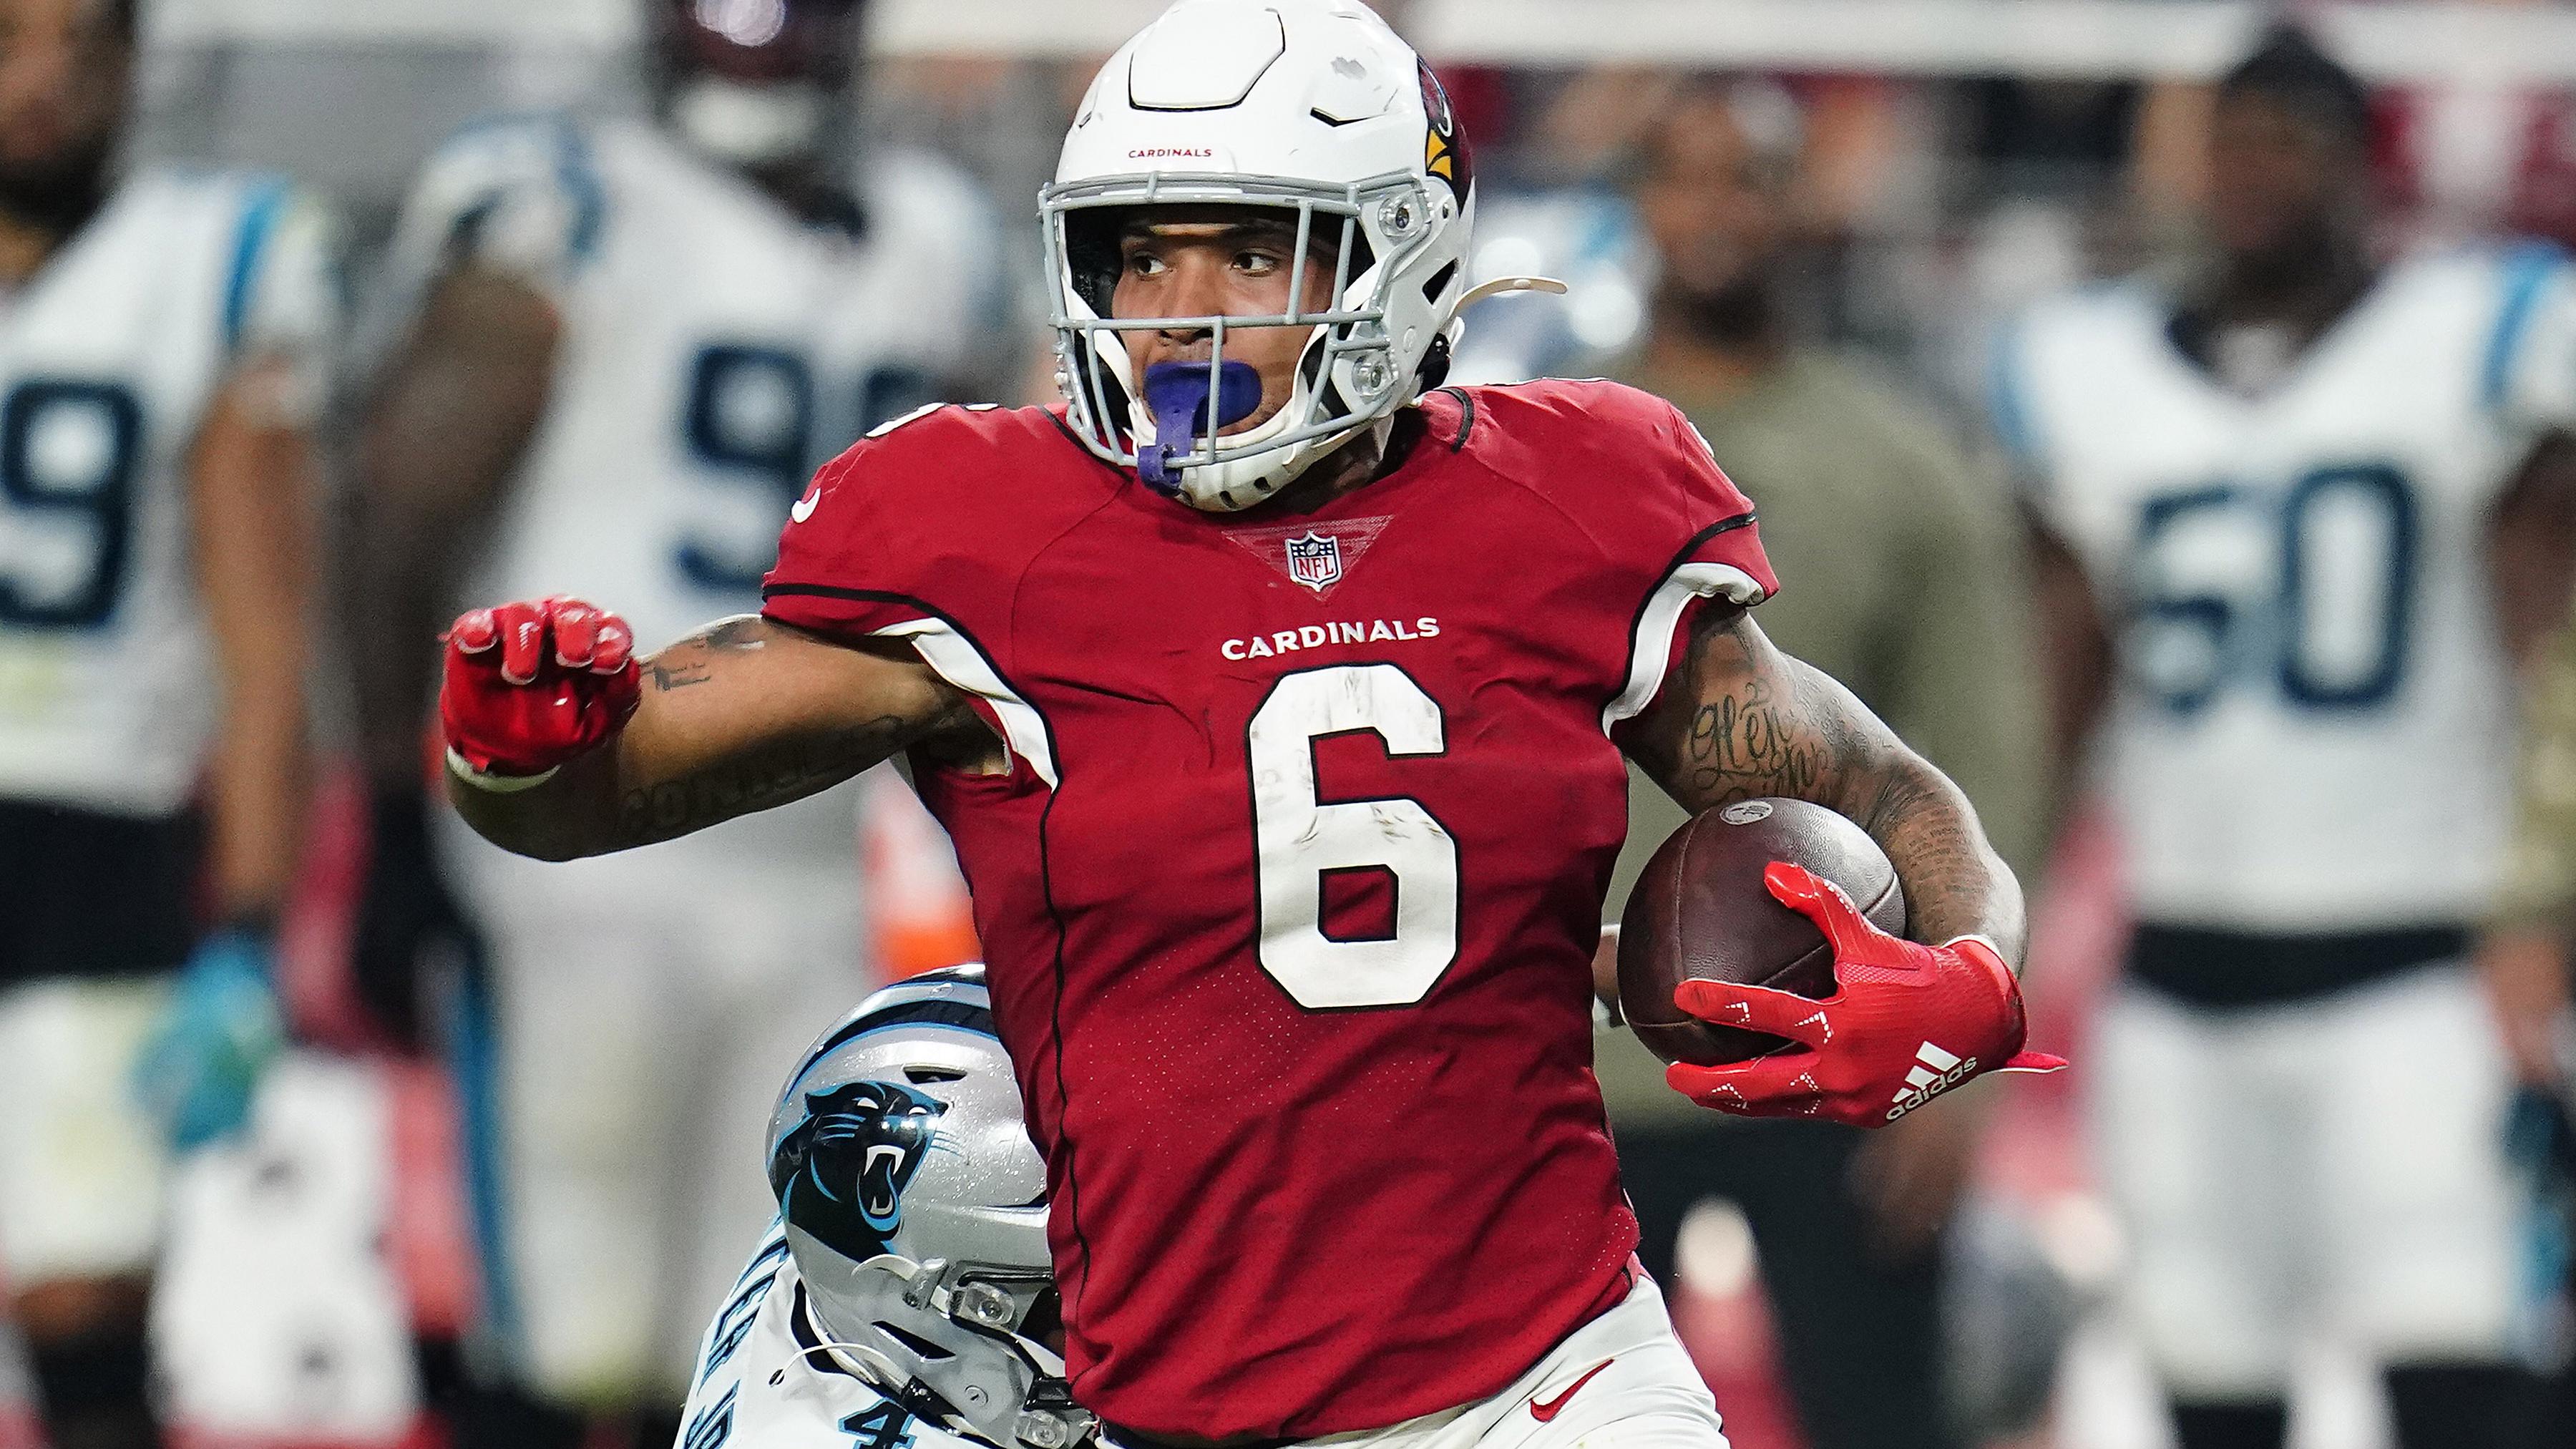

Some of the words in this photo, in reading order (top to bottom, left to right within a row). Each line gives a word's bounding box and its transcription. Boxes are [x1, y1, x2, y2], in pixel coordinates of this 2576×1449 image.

[1128, 149, 1212, 158] CARDINALS
[1296, 557, 1334, 579] NFL
[2137, 464, 2417, 708] 50
[1221, 617, 1440, 660] CARDINALS
[1246, 662, 1461, 1013] 6
[1886, 1056, 1976, 1120] adidas
[838, 1396, 917, 1449] 4
